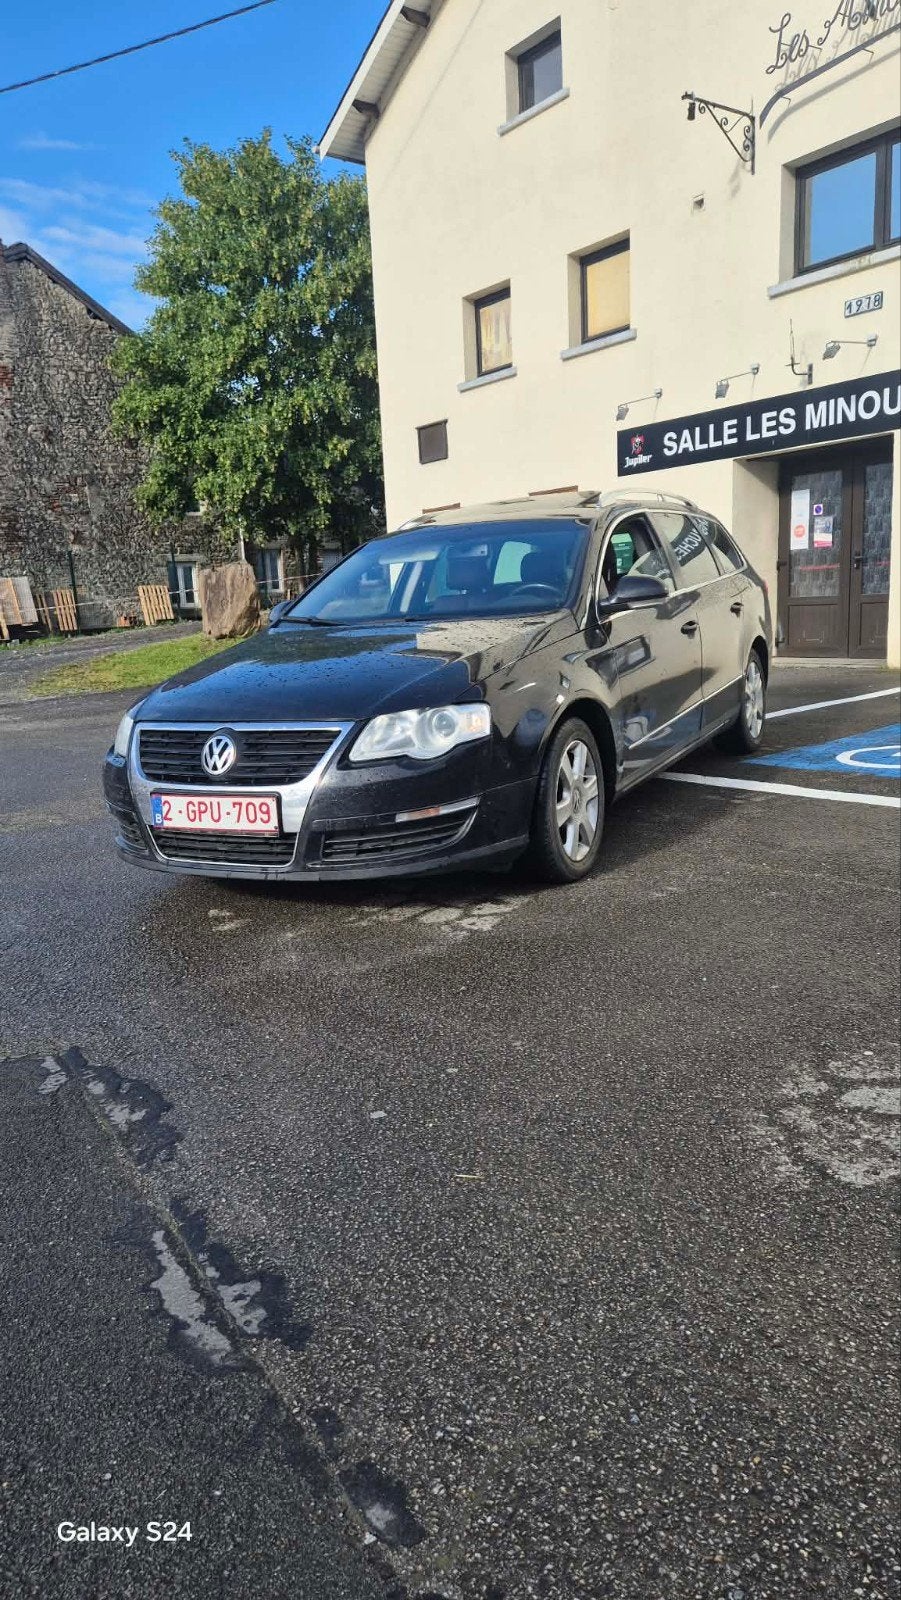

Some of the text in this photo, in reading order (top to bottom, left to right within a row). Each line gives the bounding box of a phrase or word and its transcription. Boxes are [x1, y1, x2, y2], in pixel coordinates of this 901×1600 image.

[766, 12, 809, 74] Les
[846, 294, 881, 314] 1978
[663, 384, 901, 457] SALLE LES MINOU
[623, 454, 653, 468] Jupiler
[155, 813, 163, 823] B
